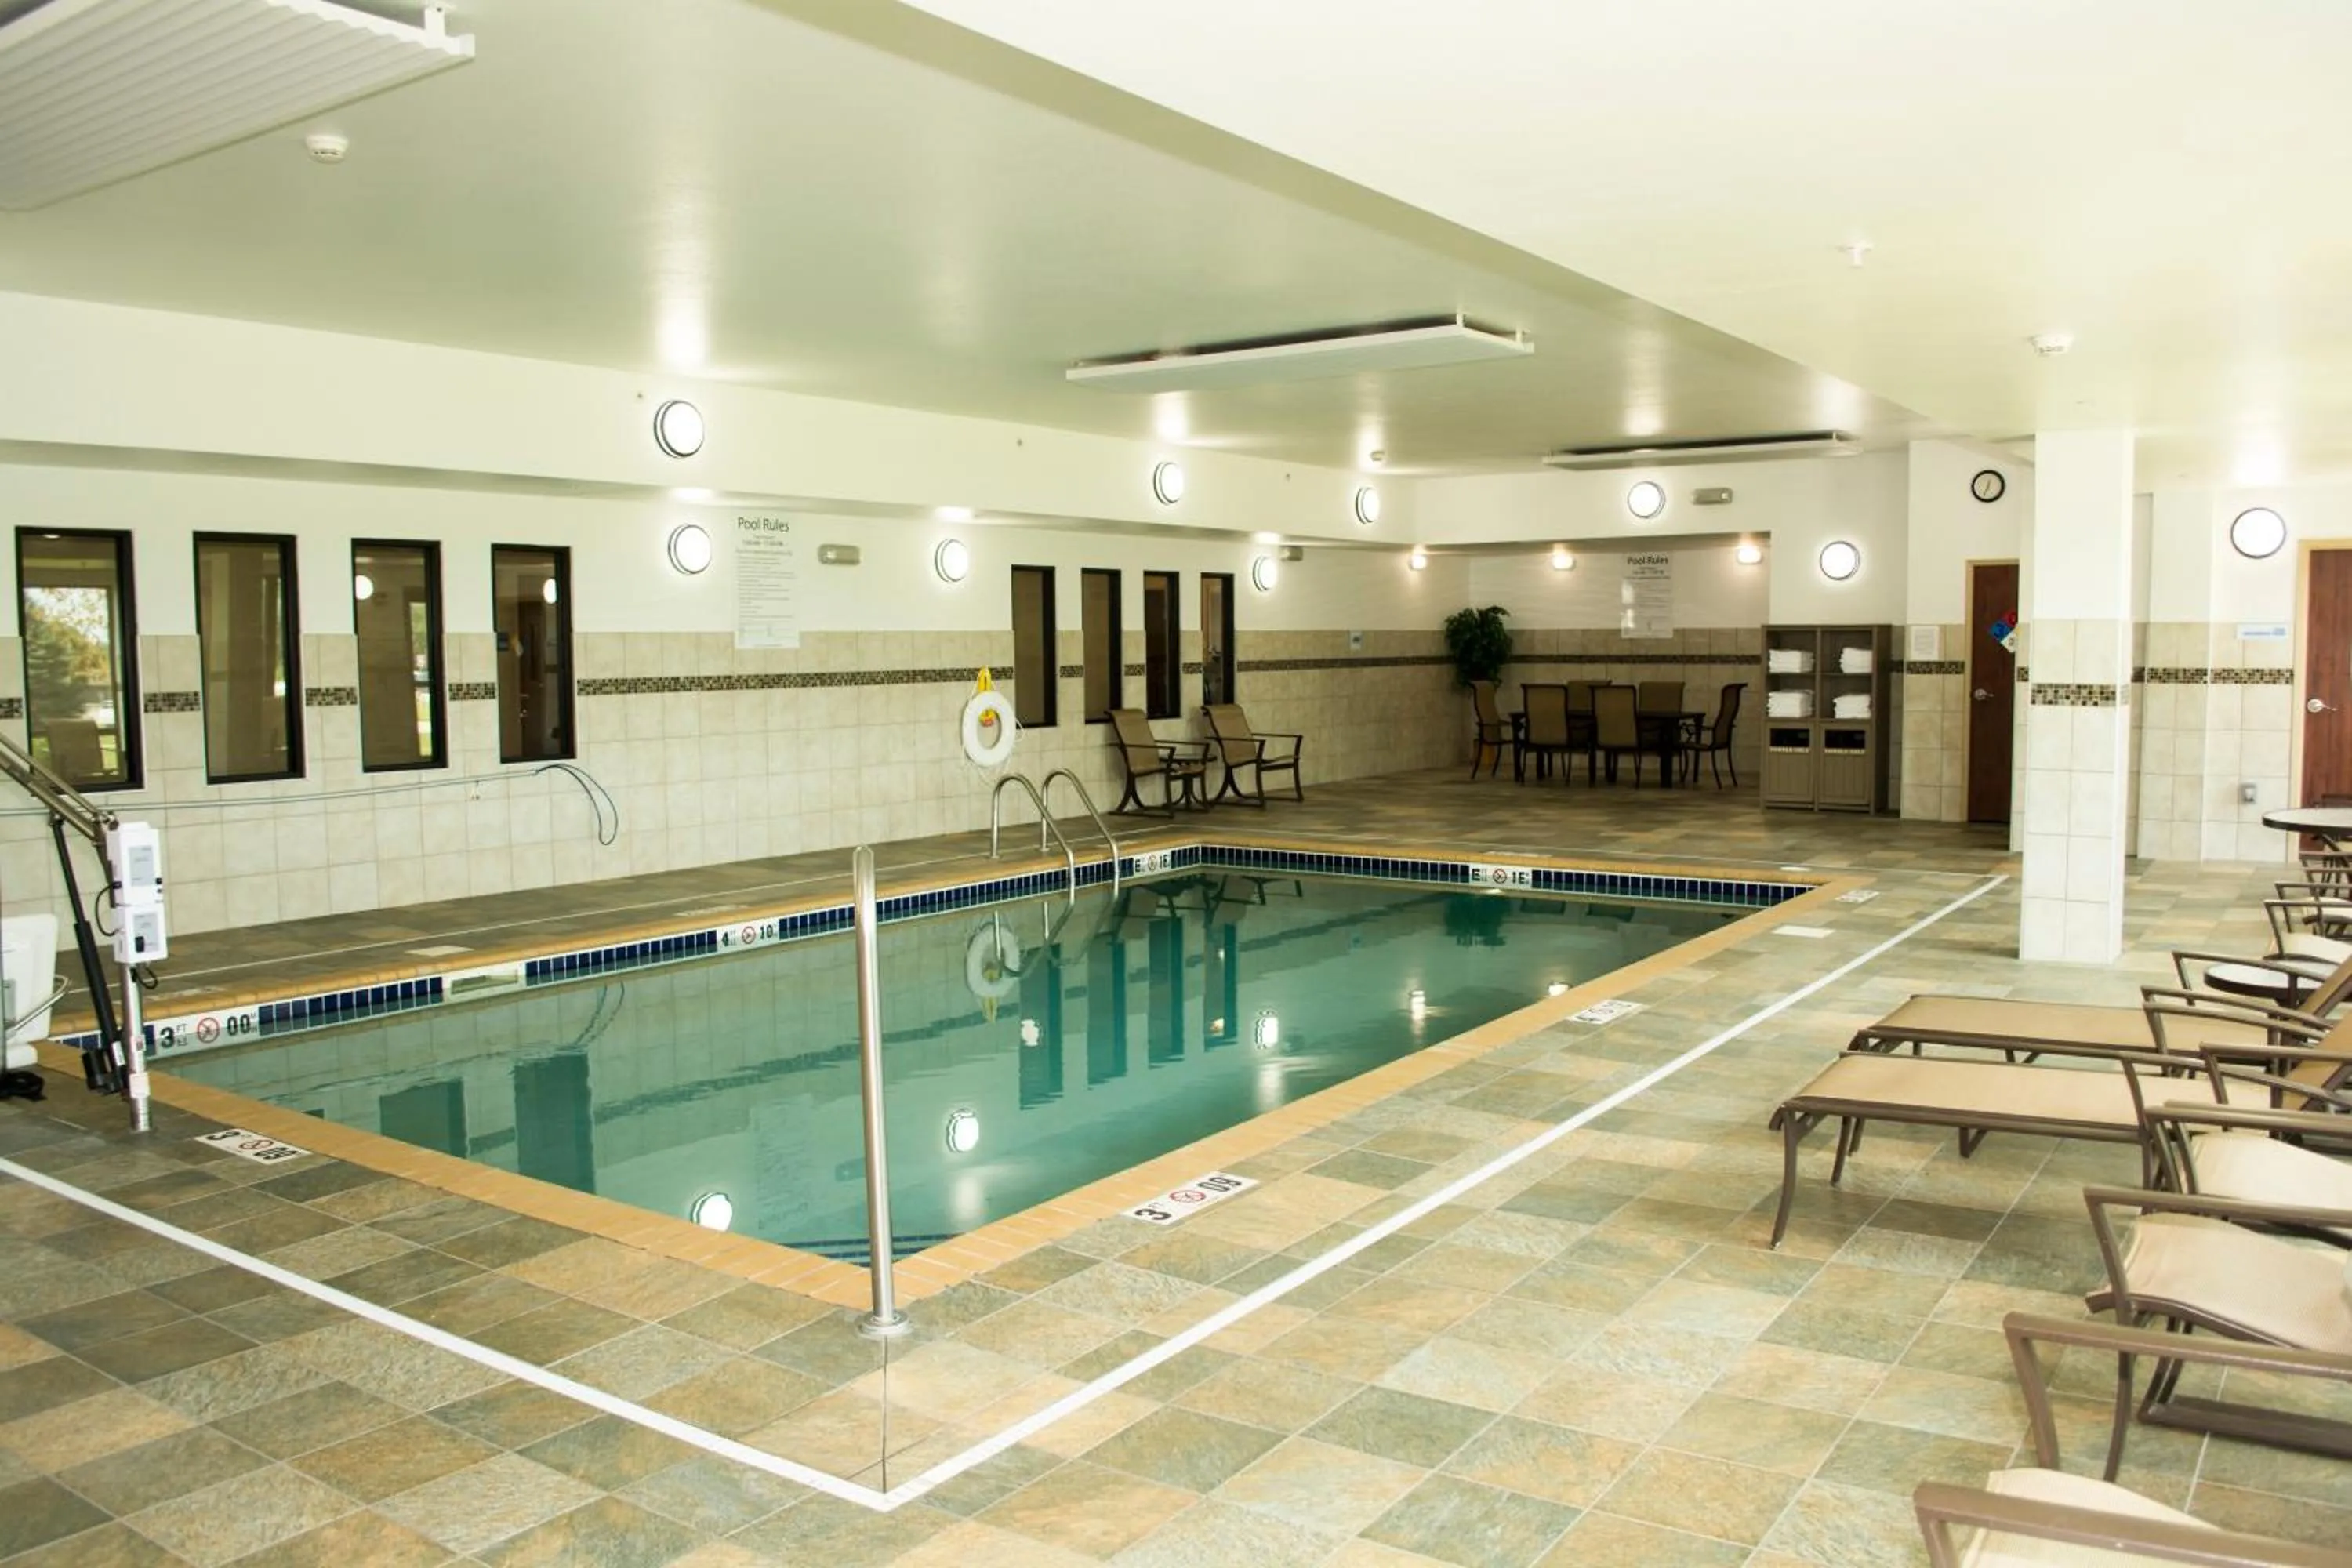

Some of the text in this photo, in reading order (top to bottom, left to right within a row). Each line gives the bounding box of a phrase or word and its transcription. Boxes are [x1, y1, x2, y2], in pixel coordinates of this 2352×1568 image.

[738, 517, 789, 532] Pool Rules
[1627, 555, 1668, 565] Pool Rules
[160, 1026, 175, 1049] 3
